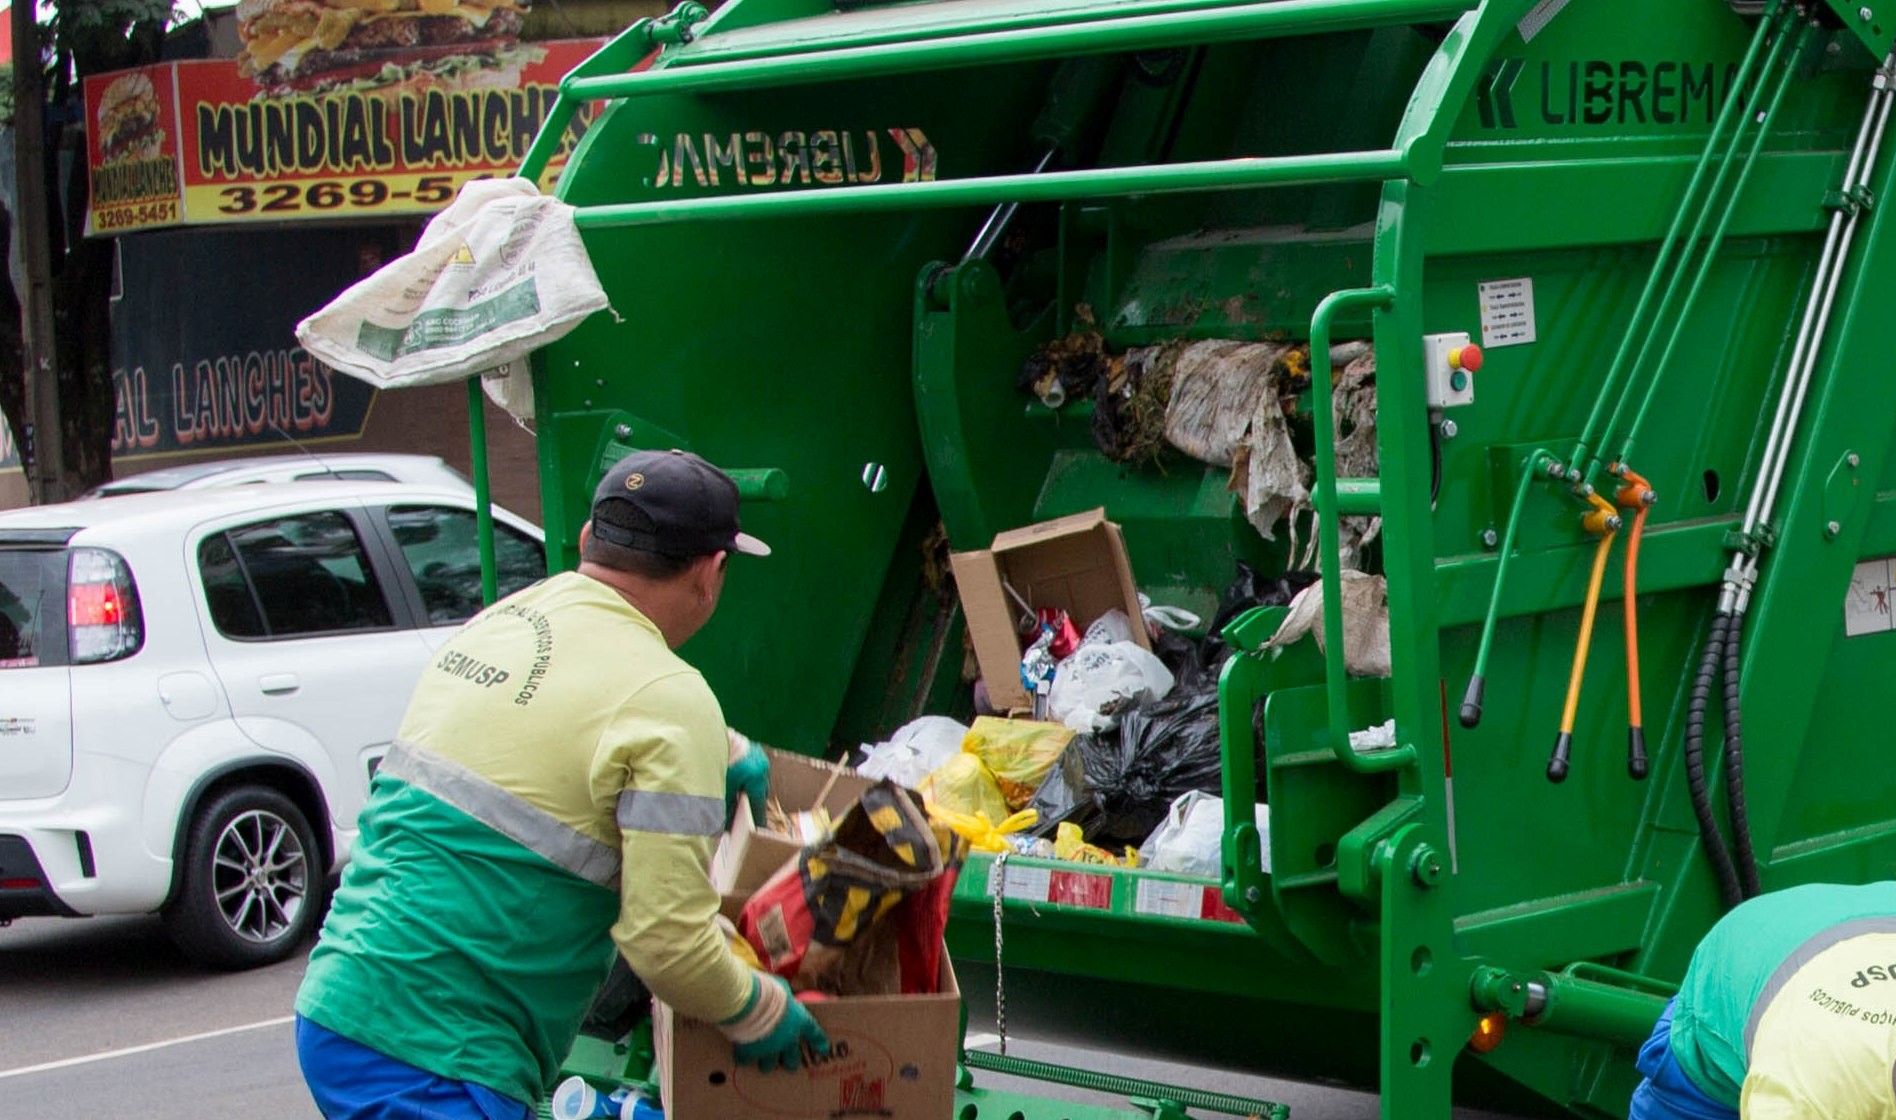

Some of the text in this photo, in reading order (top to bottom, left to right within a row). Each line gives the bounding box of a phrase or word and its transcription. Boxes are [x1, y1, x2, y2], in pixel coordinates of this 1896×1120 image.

[197, 91, 395, 178] MUNDIAL
[218, 175, 560, 214] 3269-5
[172, 349, 334, 444] LANCHES
[436, 650, 510, 688] SEMUSP
